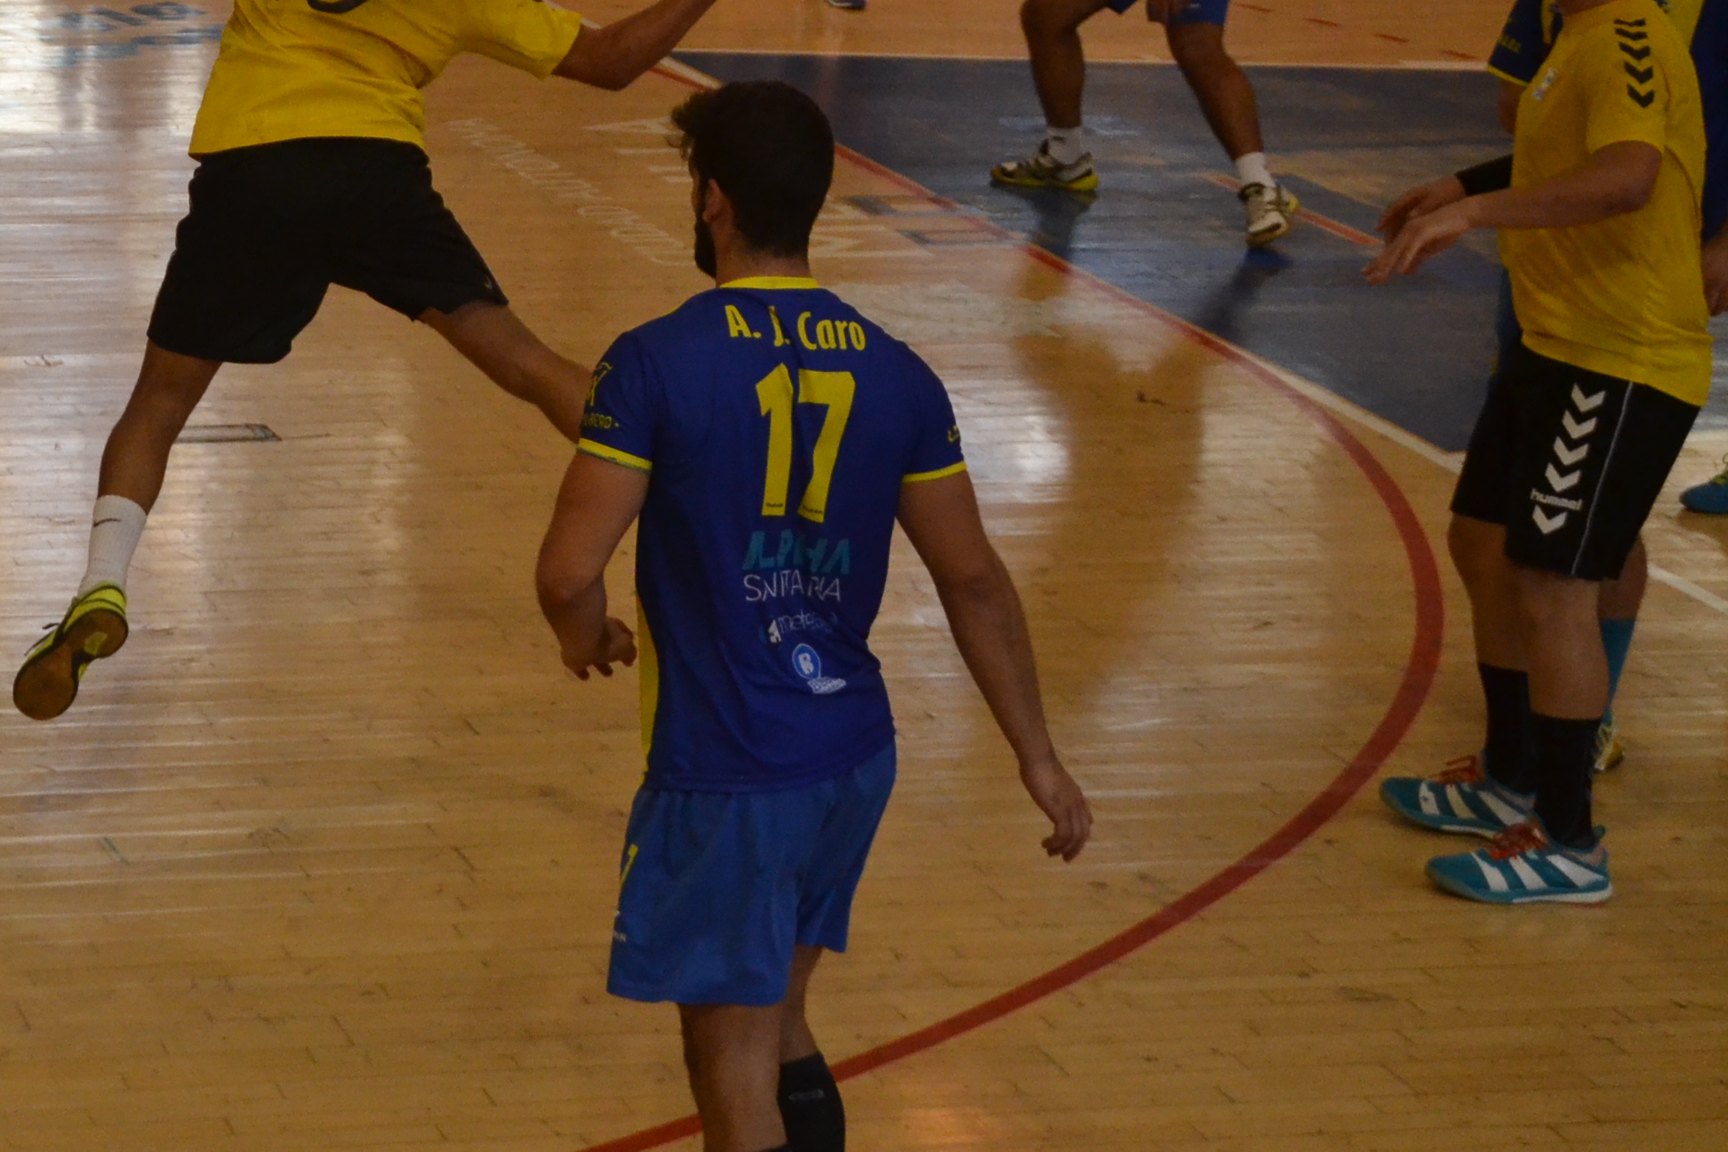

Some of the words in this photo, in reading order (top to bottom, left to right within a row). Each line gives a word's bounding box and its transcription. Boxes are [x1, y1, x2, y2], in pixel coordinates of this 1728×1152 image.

[725, 305, 761, 339] A.
[769, 306, 791, 347] J.
[797, 311, 866, 352] Caro
[755, 362, 856, 523] 17
[1530, 488, 1584, 512] hummel
